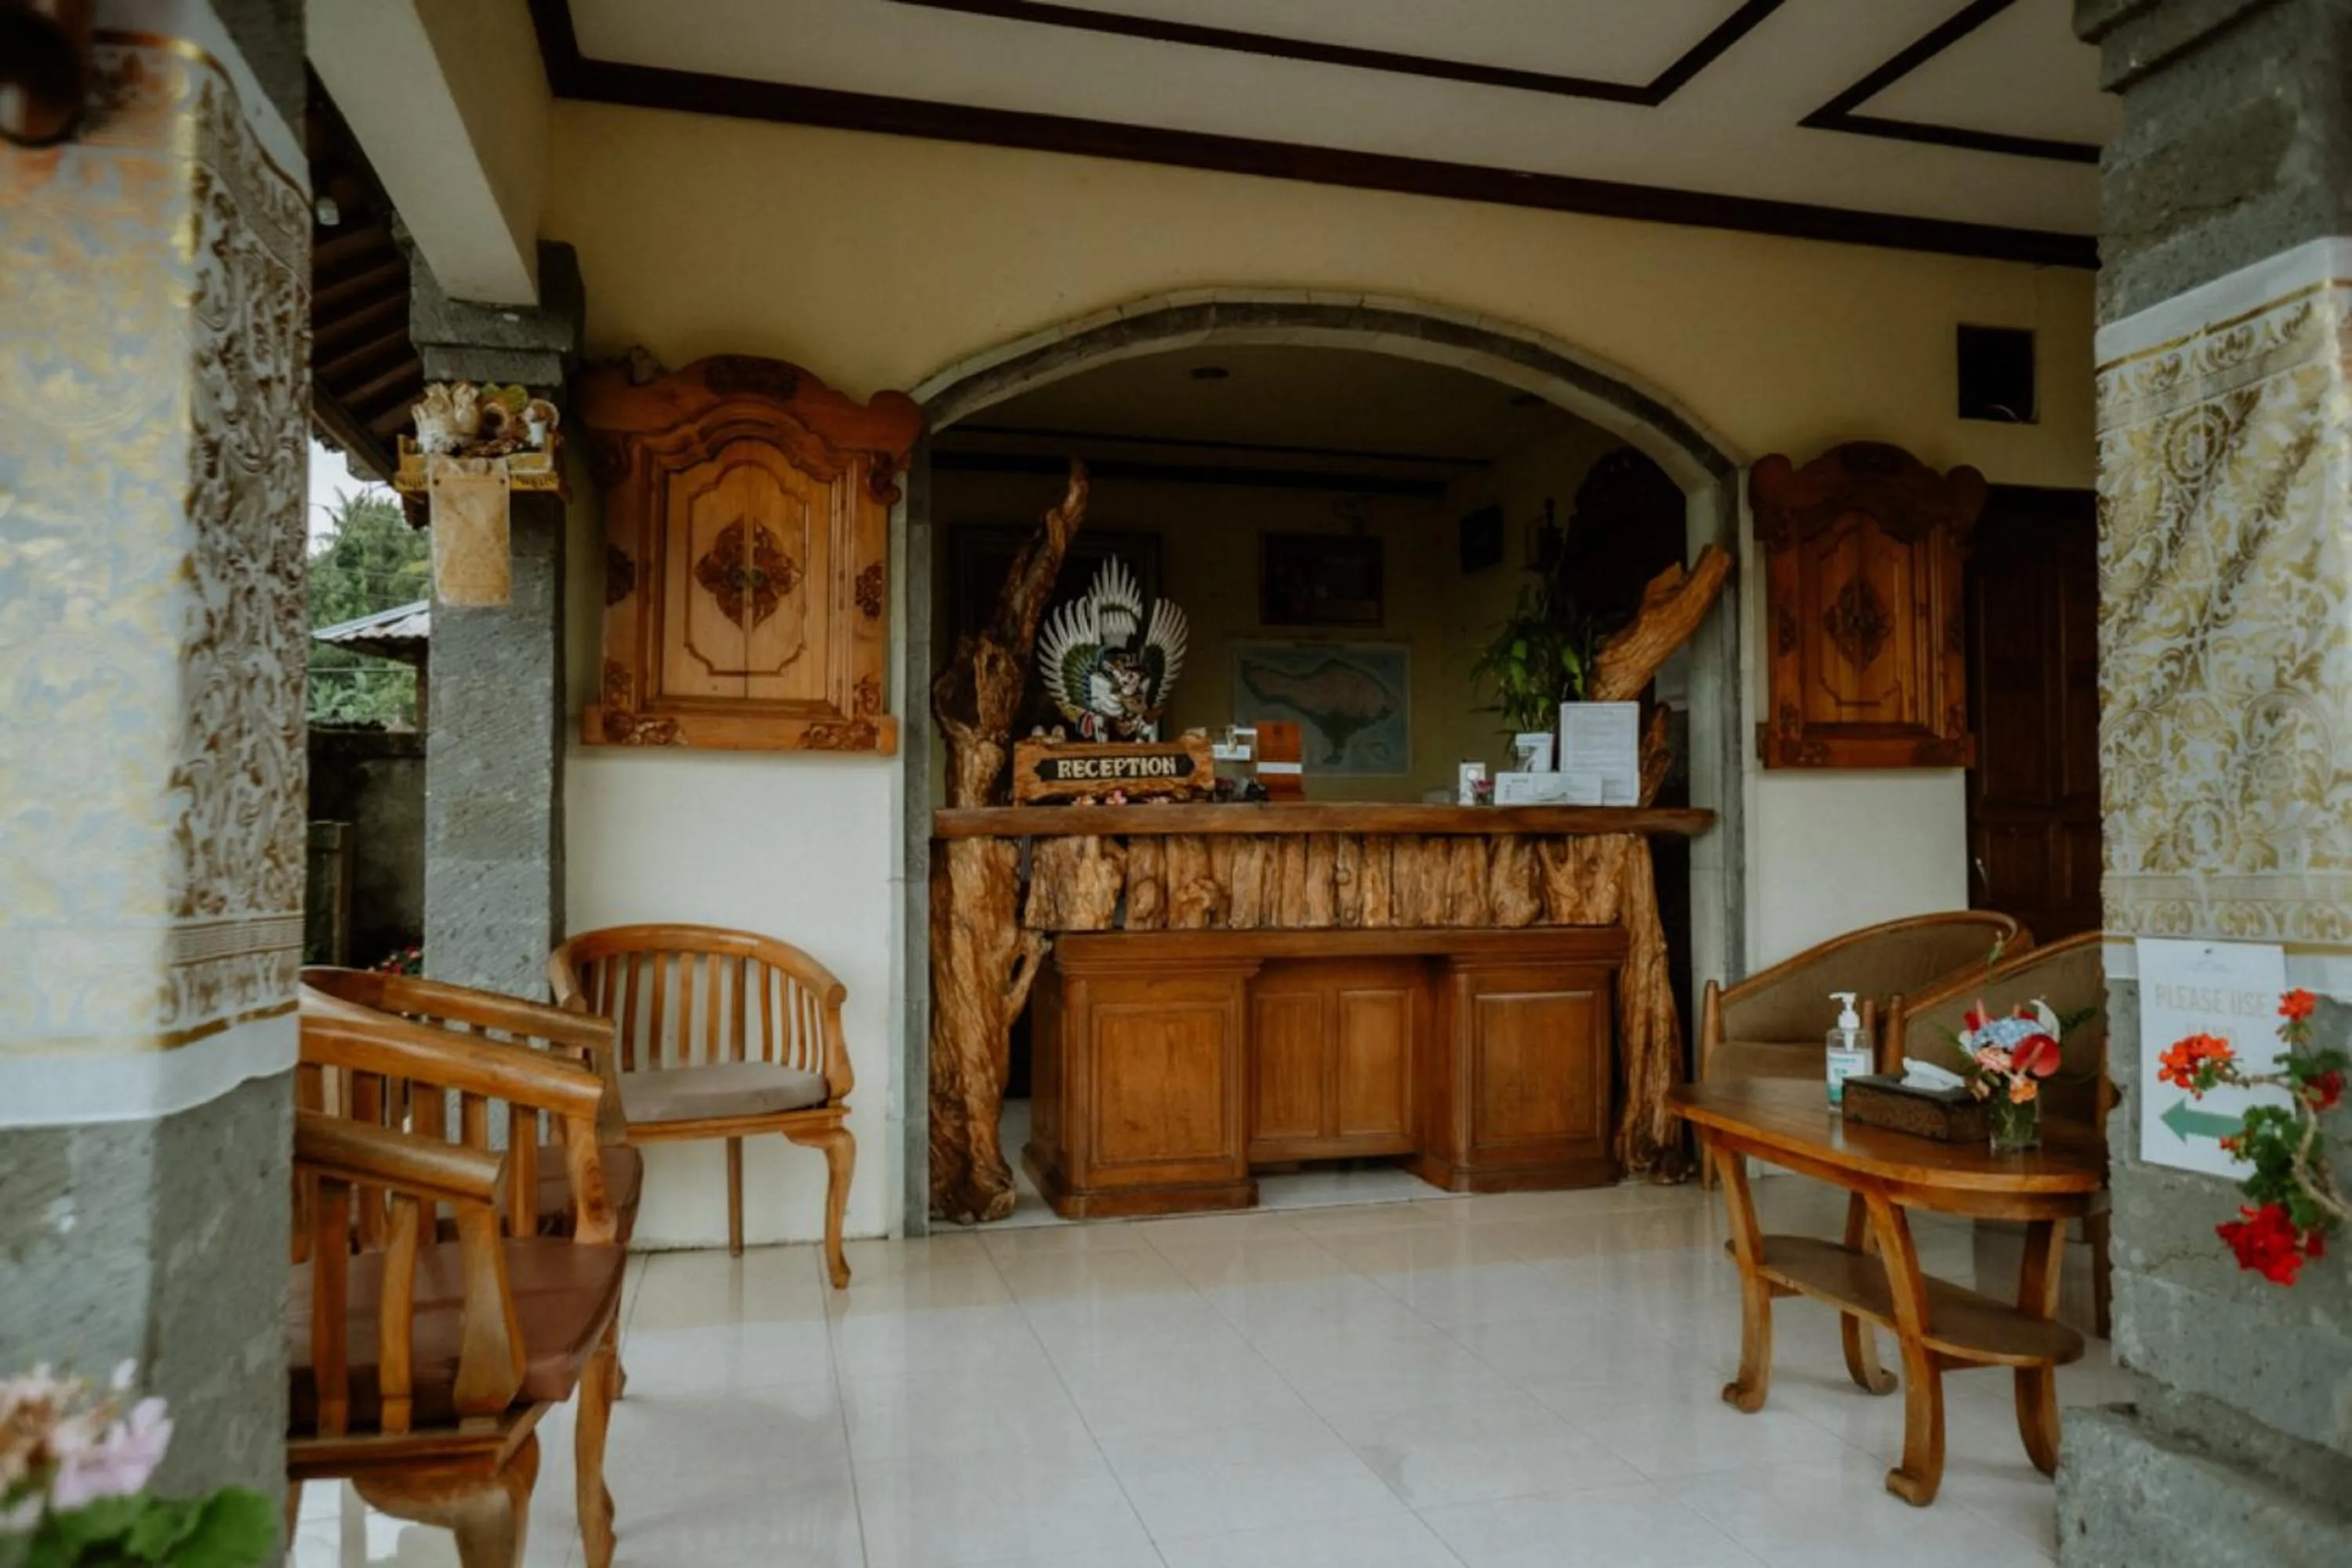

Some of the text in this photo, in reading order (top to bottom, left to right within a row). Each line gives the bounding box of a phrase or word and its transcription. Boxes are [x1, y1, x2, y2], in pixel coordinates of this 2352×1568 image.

[1058, 756, 1176, 779] RECEPTION
[2154, 983, 2270, 1018] PLEASE USE
